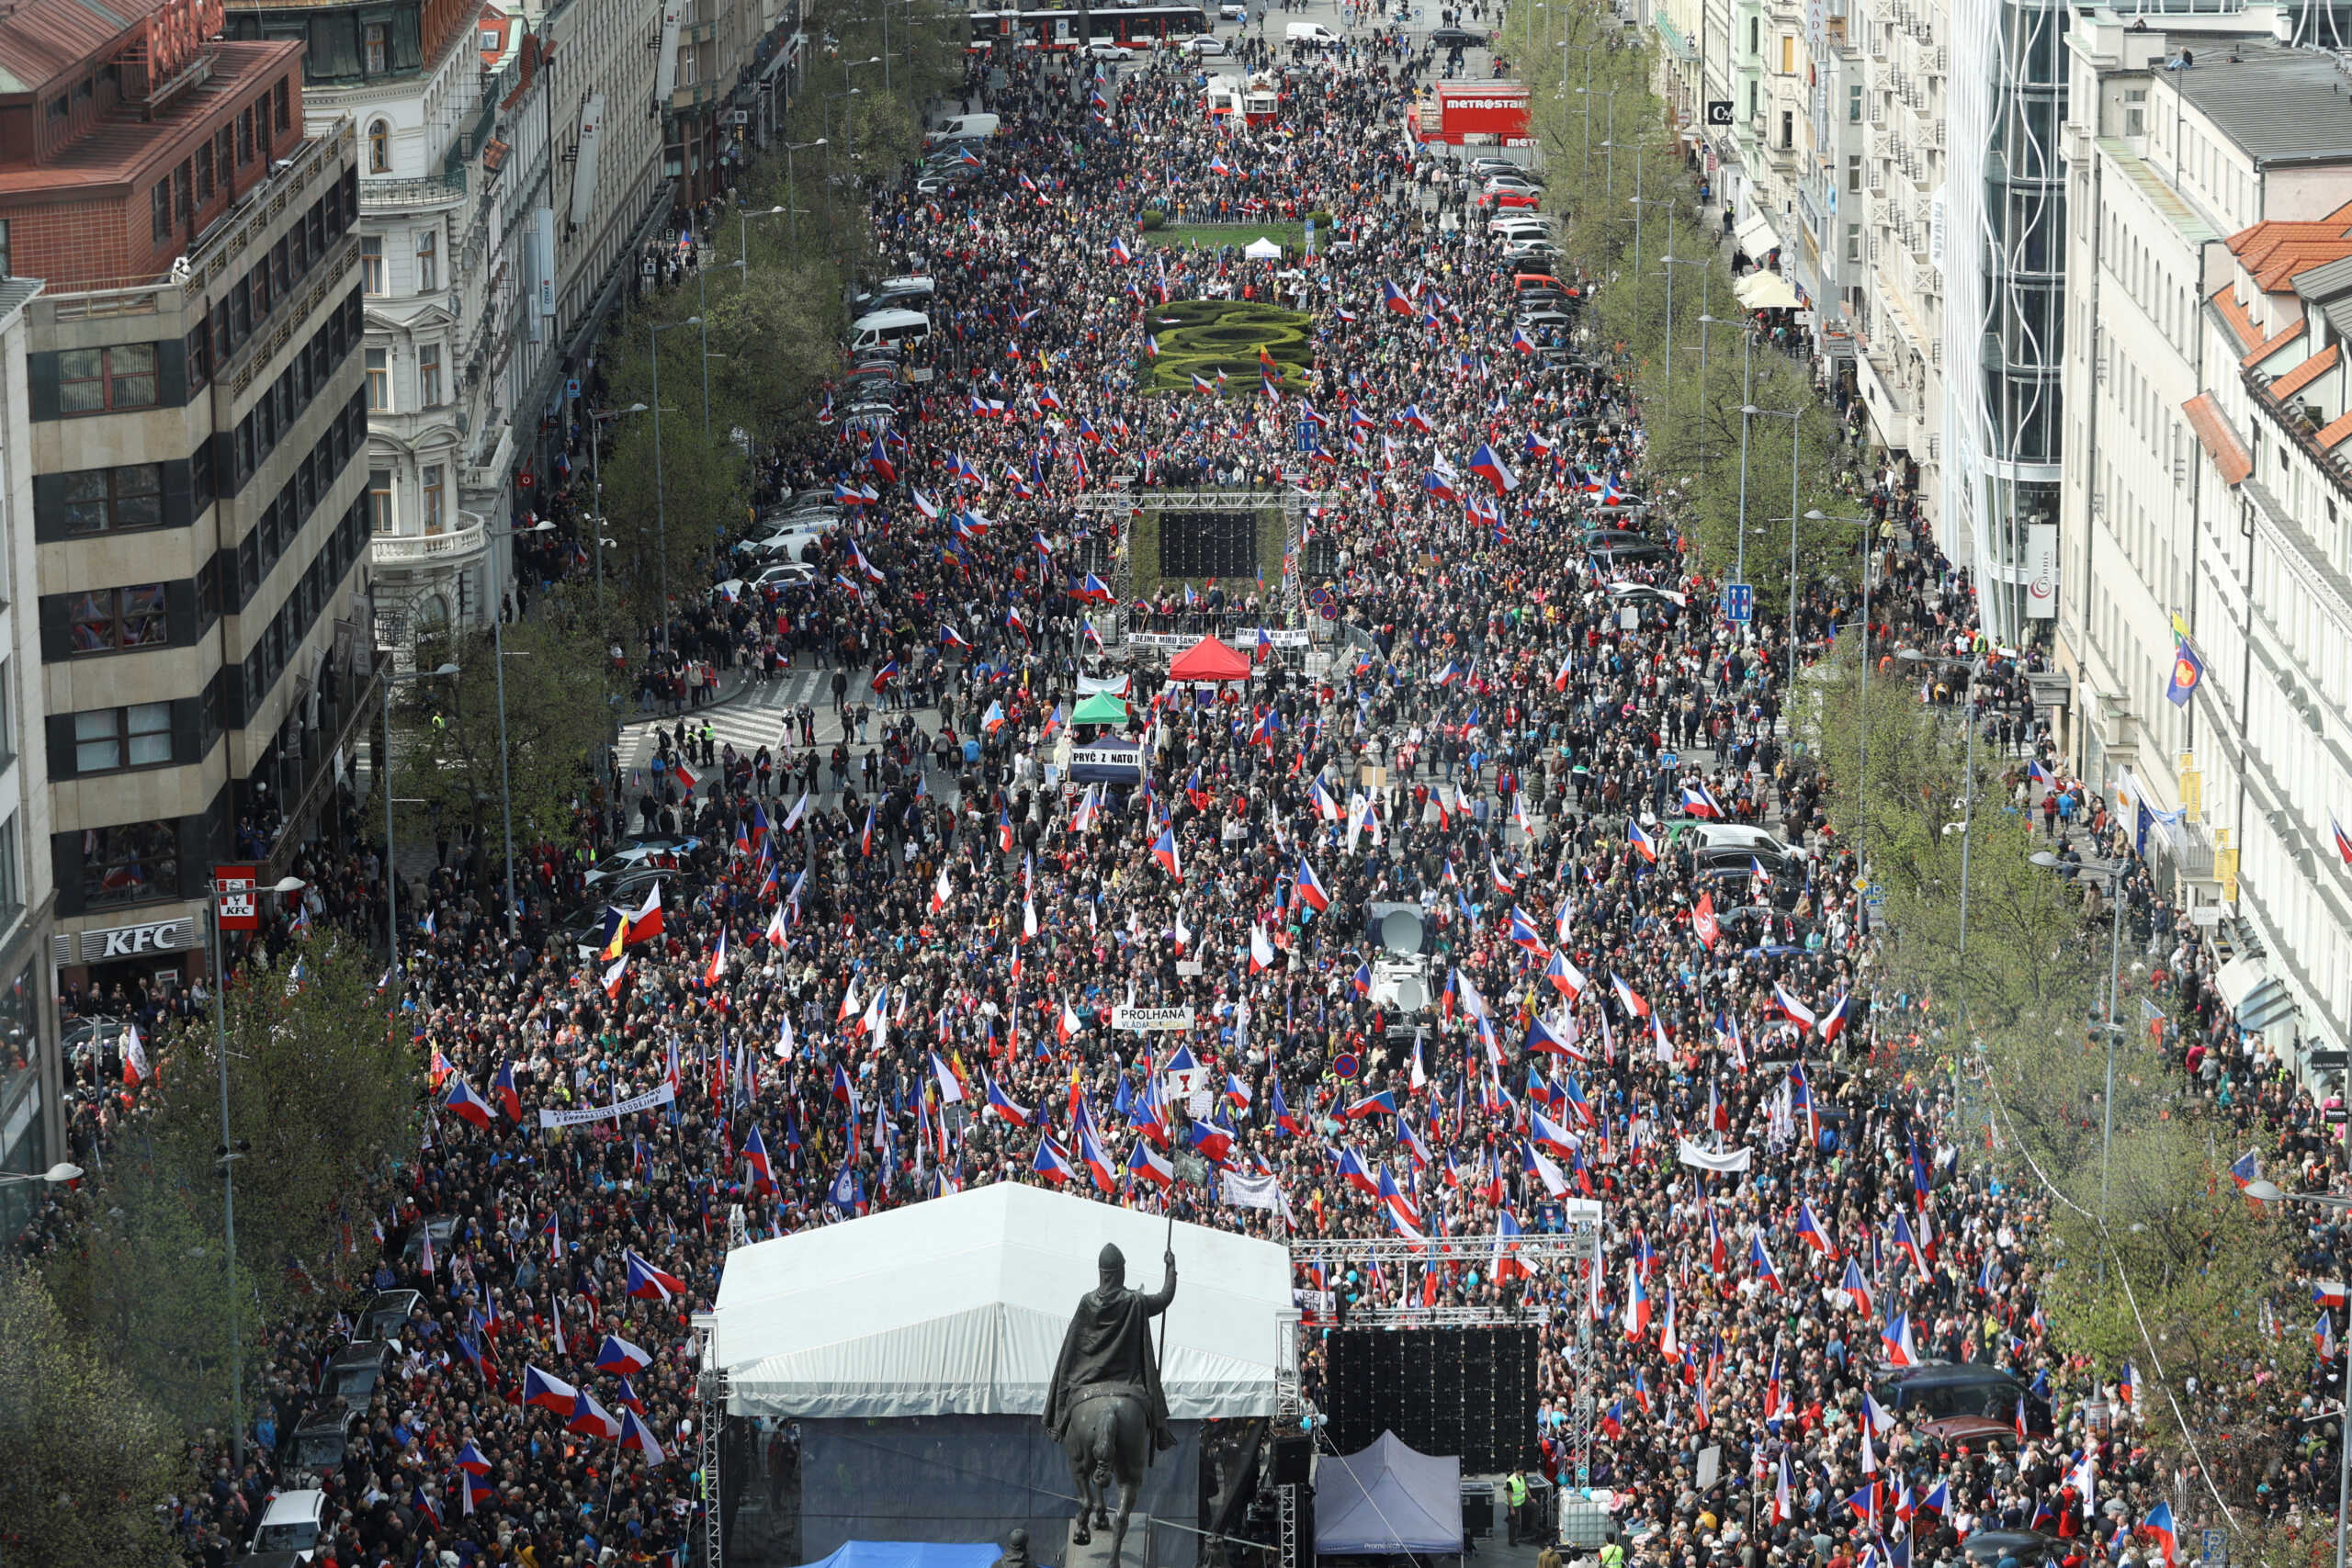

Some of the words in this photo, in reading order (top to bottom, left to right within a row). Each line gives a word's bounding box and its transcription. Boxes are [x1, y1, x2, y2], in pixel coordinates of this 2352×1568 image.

[1073, 751, 1096, 762] PRYČ
[1102, 753, 1106, 763] Z
[227, 907, 249, 915] KFC
[103, 924, 177, 957] KFC
[1121, 1009, 1185, 1020] PROLHANÁ
